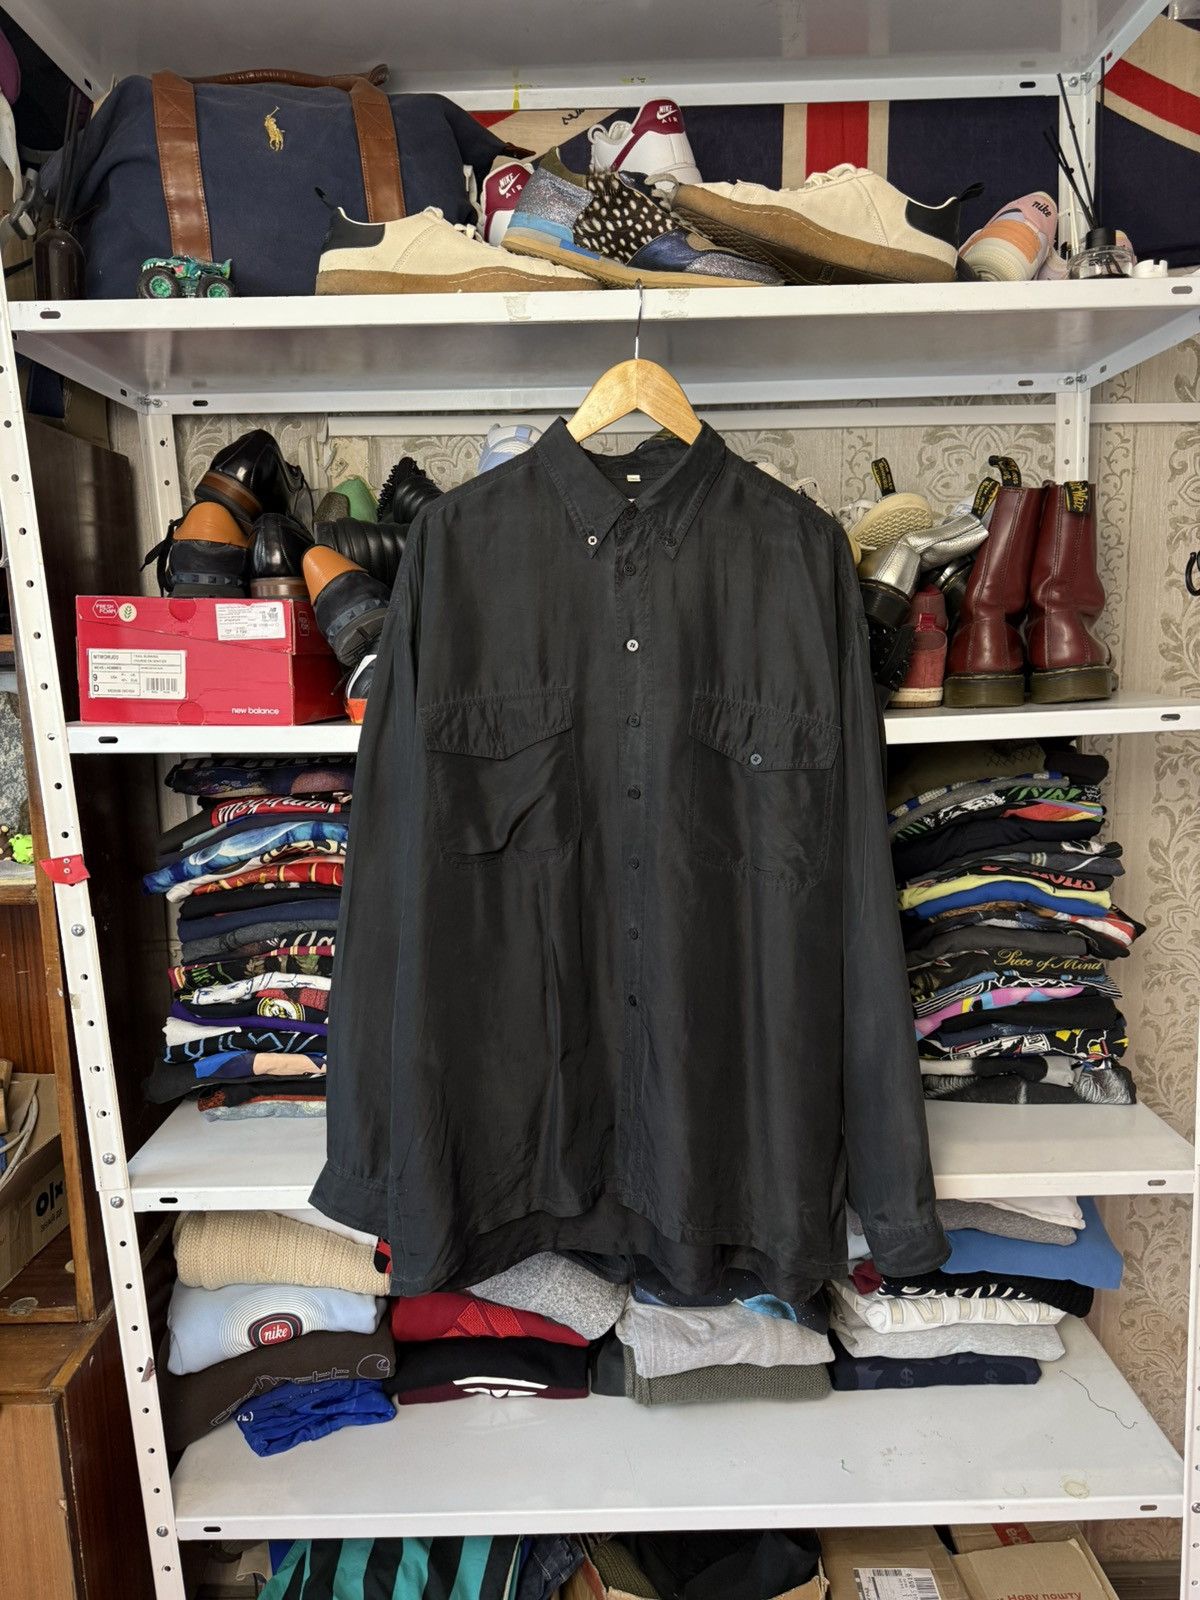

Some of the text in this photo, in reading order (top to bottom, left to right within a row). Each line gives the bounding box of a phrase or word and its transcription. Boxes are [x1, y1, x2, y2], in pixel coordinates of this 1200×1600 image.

[659, 105, 673, 114] NIKE
[499, 172, 515, 189] NIKE
[505, 184, 524, 199] AIR
[1031, 200, 1053, 218] nike
[92, 673, 98, 682] 9
[93, 684, 100, 692] D
[231, 705, 280, 716] new balance
[993, 948, 1103, 974] Piece of Mind
[35, 1180, 64, 1218] olx
[264, 1326, 288, 1342] nike
